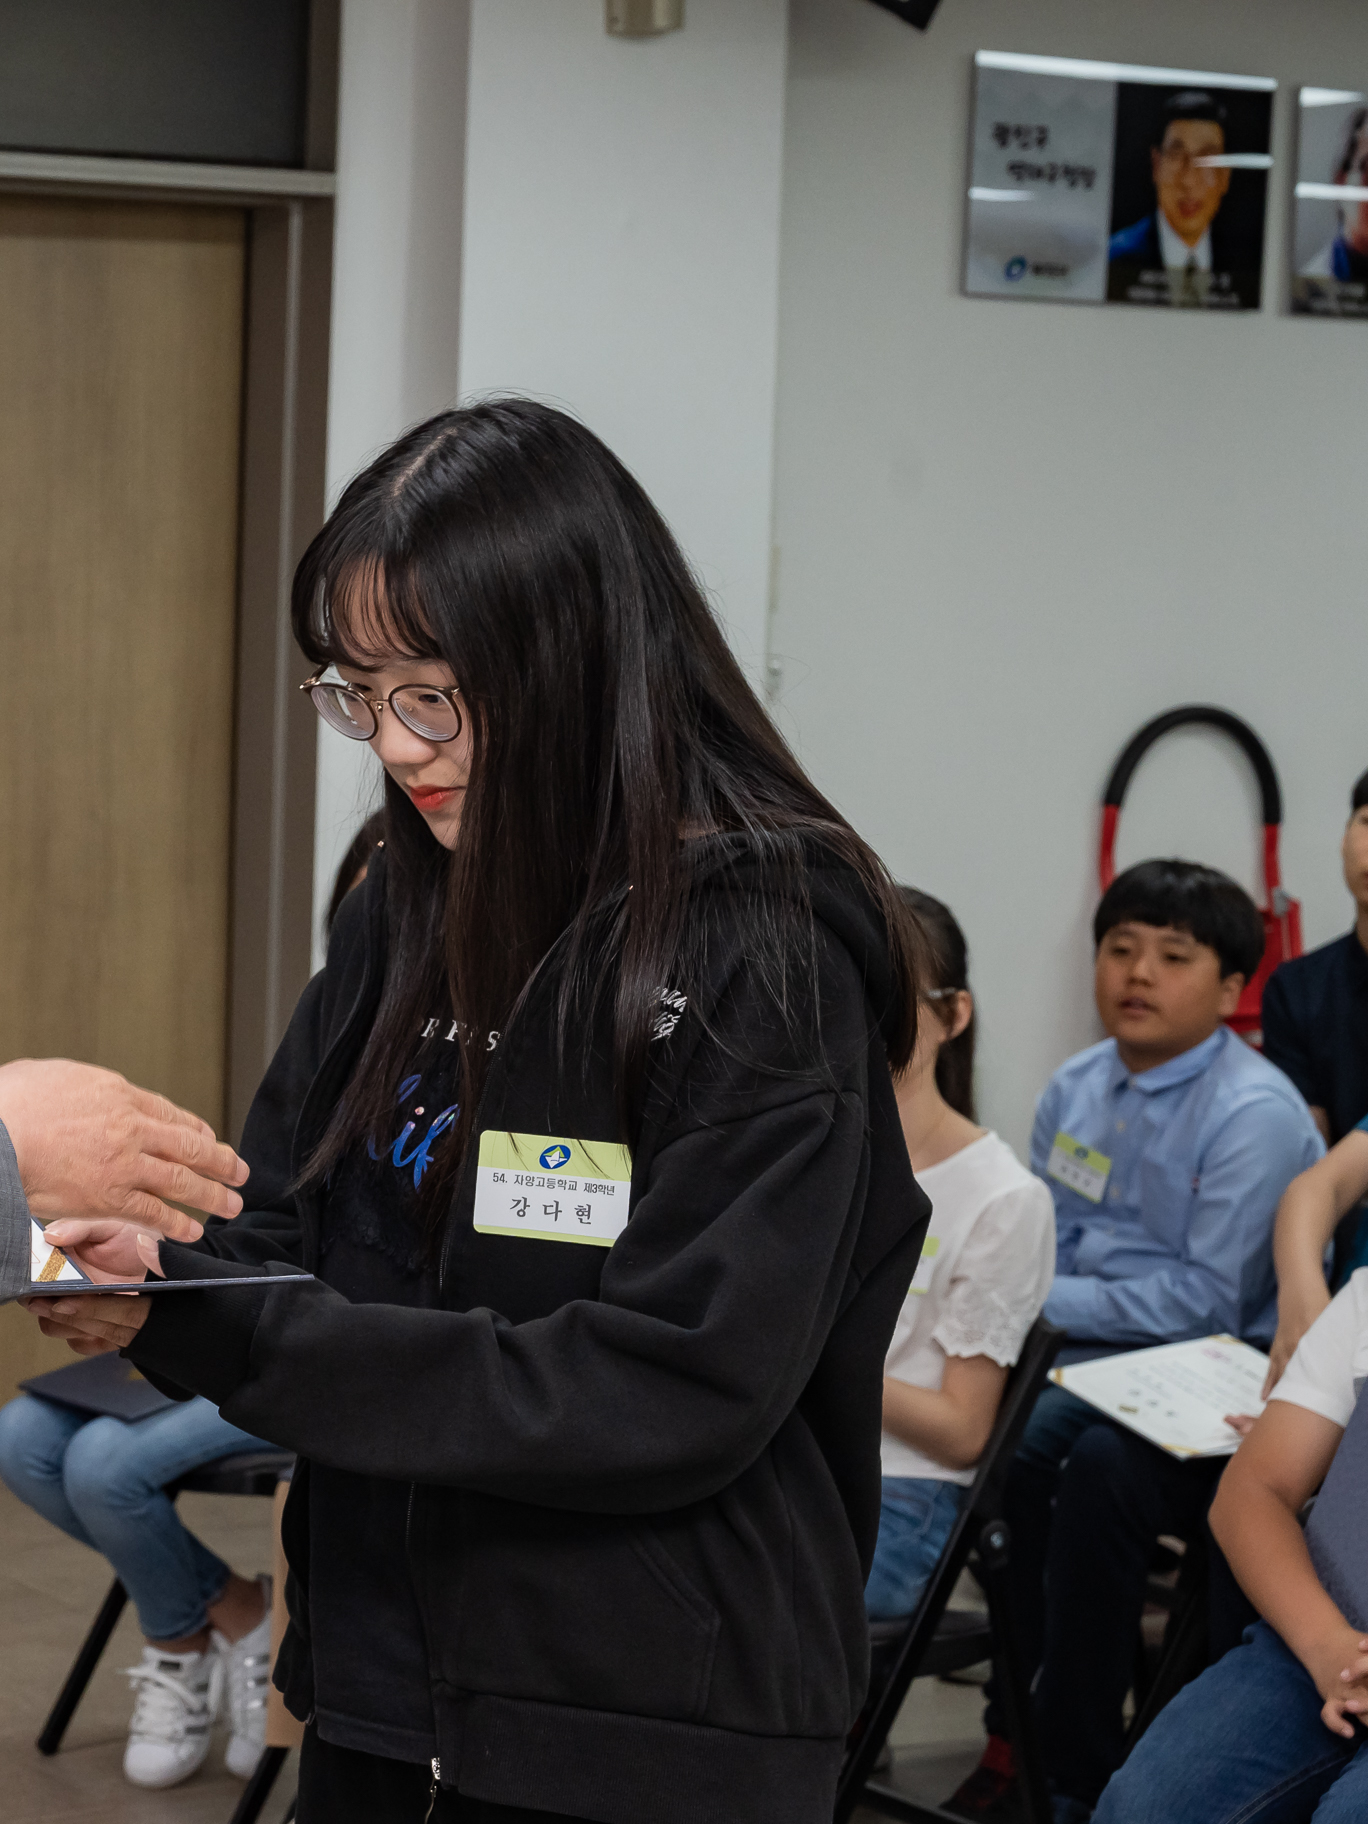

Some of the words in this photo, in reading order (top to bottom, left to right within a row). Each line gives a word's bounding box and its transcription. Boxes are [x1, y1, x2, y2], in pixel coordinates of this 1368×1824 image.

[492, 1172, 508, 1184] 54.
[513, 1174, 578, 1191] 자양고등학교
[583, 1182, 615, 1196] 제3학년
